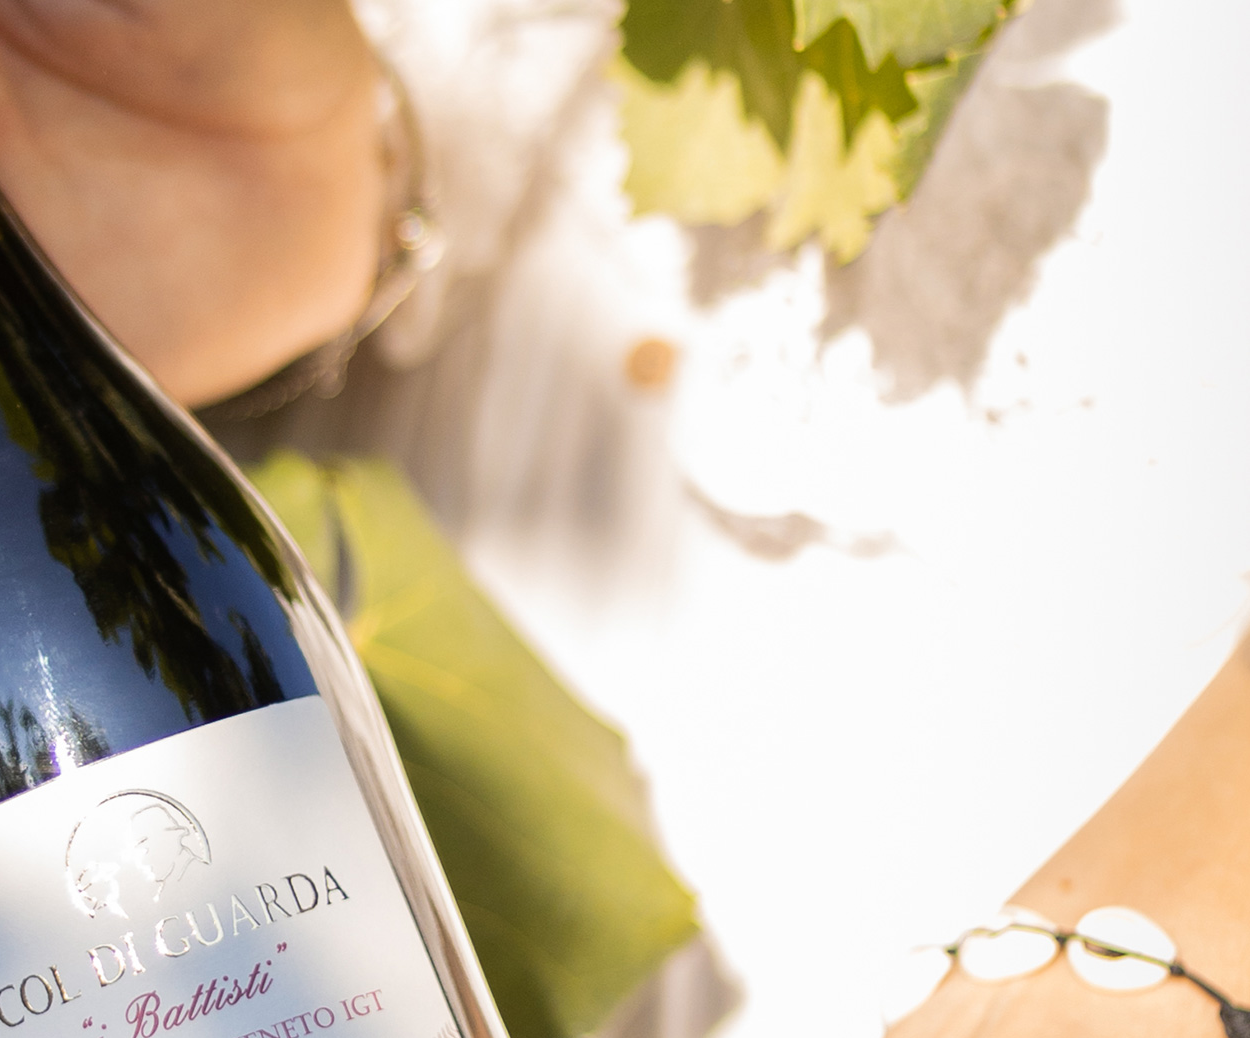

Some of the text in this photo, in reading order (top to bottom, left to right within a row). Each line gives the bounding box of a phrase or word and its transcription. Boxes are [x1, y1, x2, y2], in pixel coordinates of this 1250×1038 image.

[88, 931, 146, 987] DI
[155, 865, 350, 958] GUARDA
[340, 989, 385, 1021] IGT
